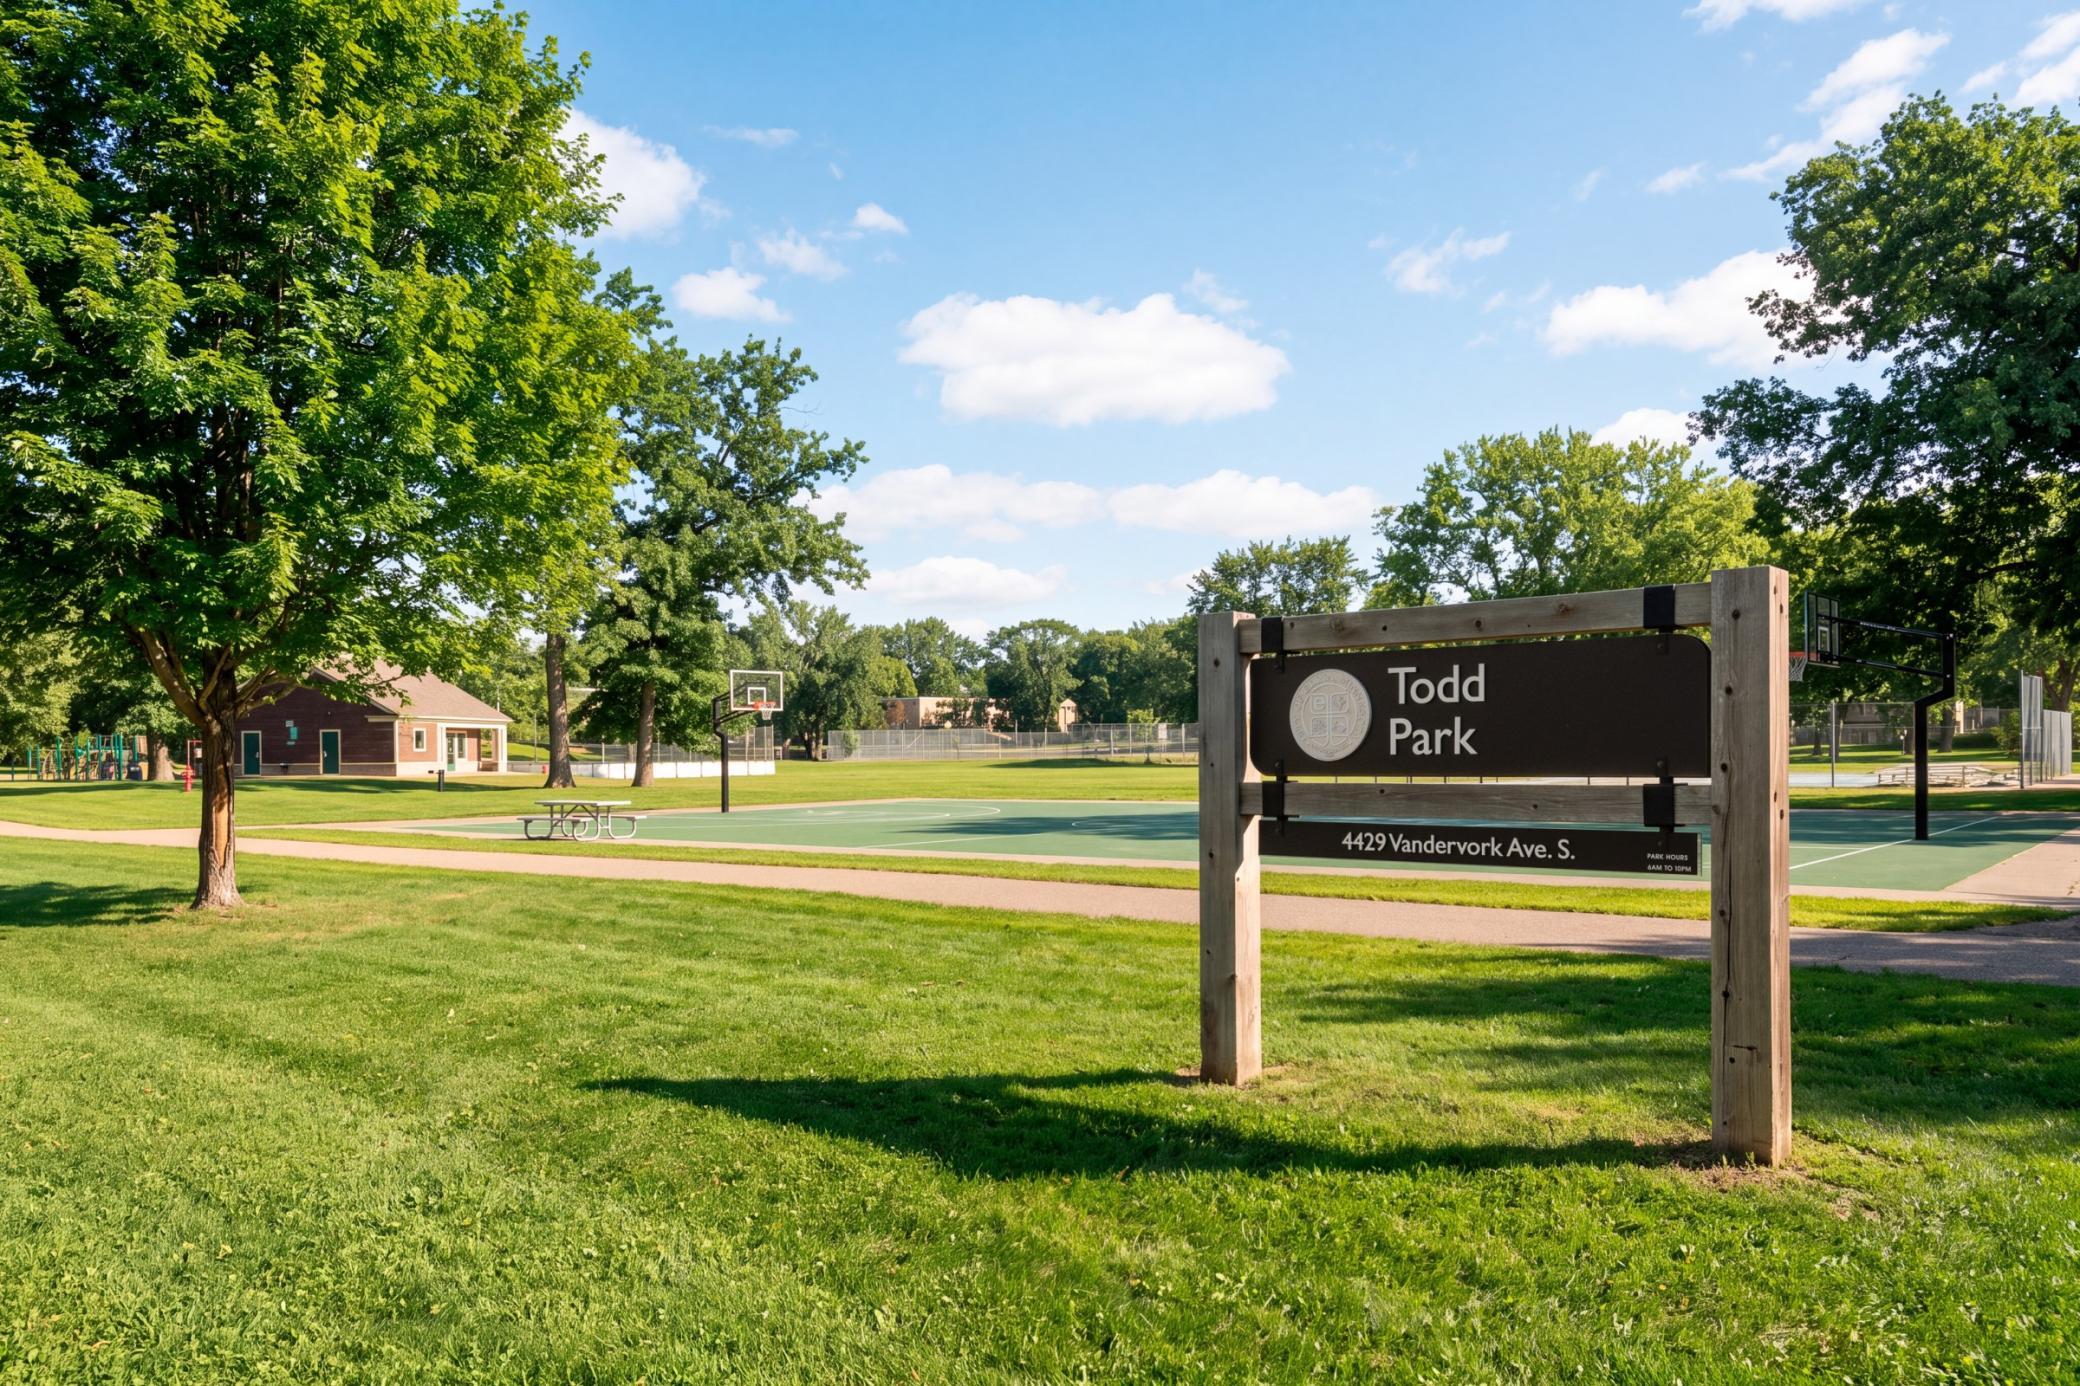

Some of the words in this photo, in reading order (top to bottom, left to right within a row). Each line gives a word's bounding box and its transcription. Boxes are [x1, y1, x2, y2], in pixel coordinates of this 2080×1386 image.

[1387, 663, 1485, 705] Todd
[1389, 716, 1478, 756] Park
[1341, 831, 1387, 851] 4429
[1388, 833, 1503, 857] Vandervork
[1506, 837, 1553, 859] Ave.
[1557, 838, 1576, 860] S.
